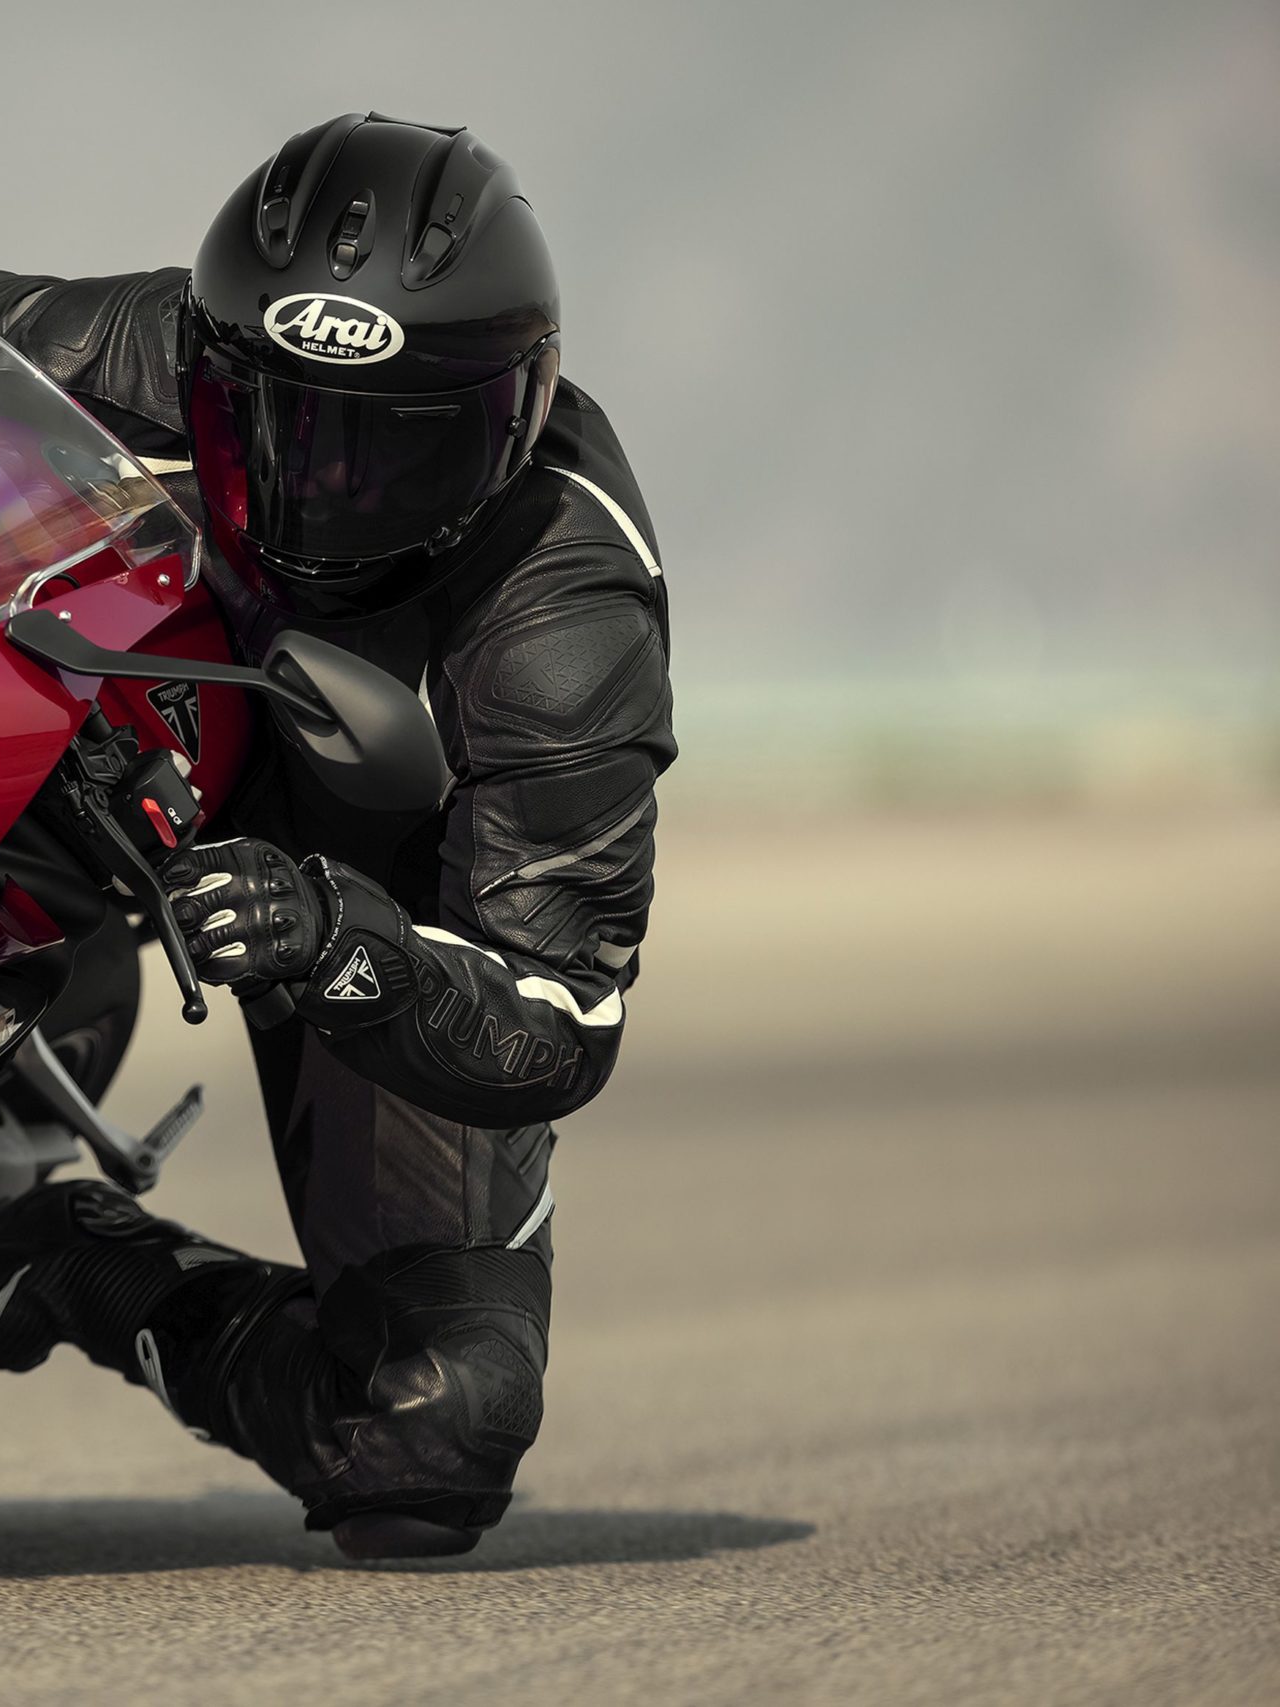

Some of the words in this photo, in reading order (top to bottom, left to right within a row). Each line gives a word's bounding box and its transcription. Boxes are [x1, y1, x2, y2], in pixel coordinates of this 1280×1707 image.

[270, 298, 389, 350] Arai
[157, 682, 189, 702] TRIUMPH
[333, 957, 361, 991] TRIUMPH
[409, 953, 584, 1089] RIUMPH
